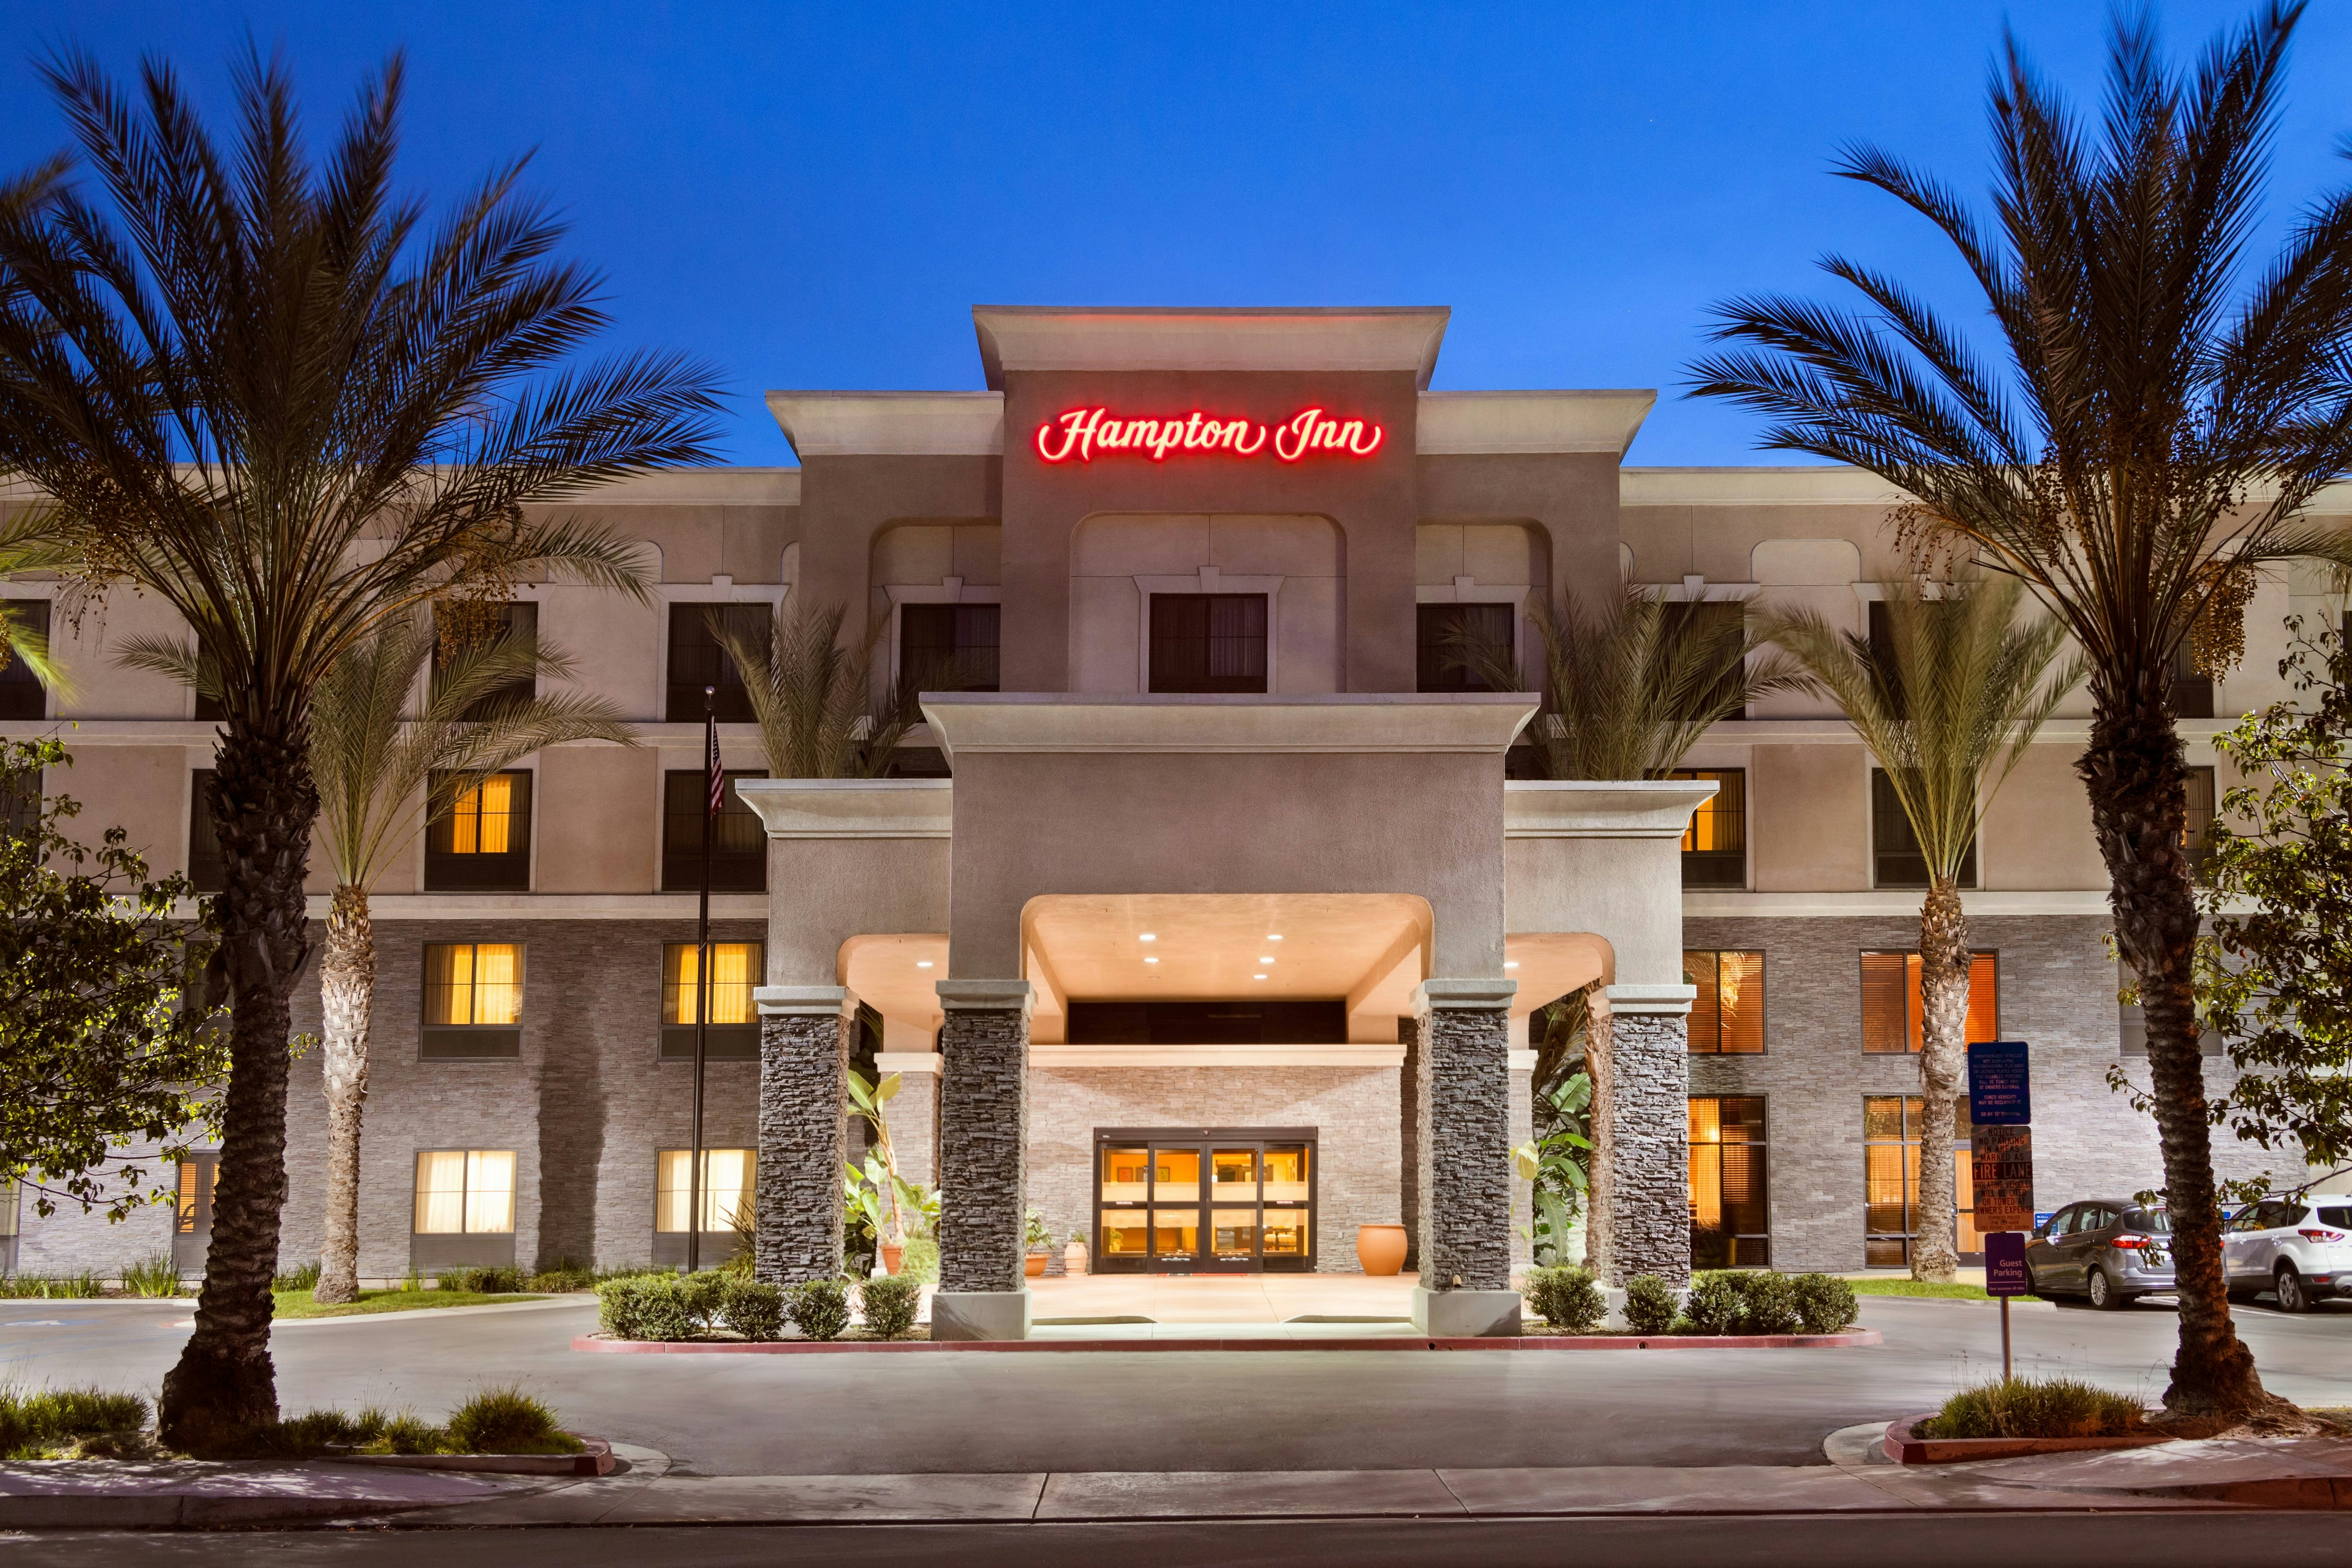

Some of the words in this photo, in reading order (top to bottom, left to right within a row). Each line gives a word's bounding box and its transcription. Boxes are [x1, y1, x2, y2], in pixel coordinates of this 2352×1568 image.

[1038, 407, 1266, 462] Hampton
[1275, 409, 1381, 460] Inn
[1974, 1165, 1998, 1179] FIRE
[2003, 1163, 2031, 1179] LANE
[1974, 1181, 2003, 1189] VIOLATING
[1993, 1269, 2022, 1277] Parking
